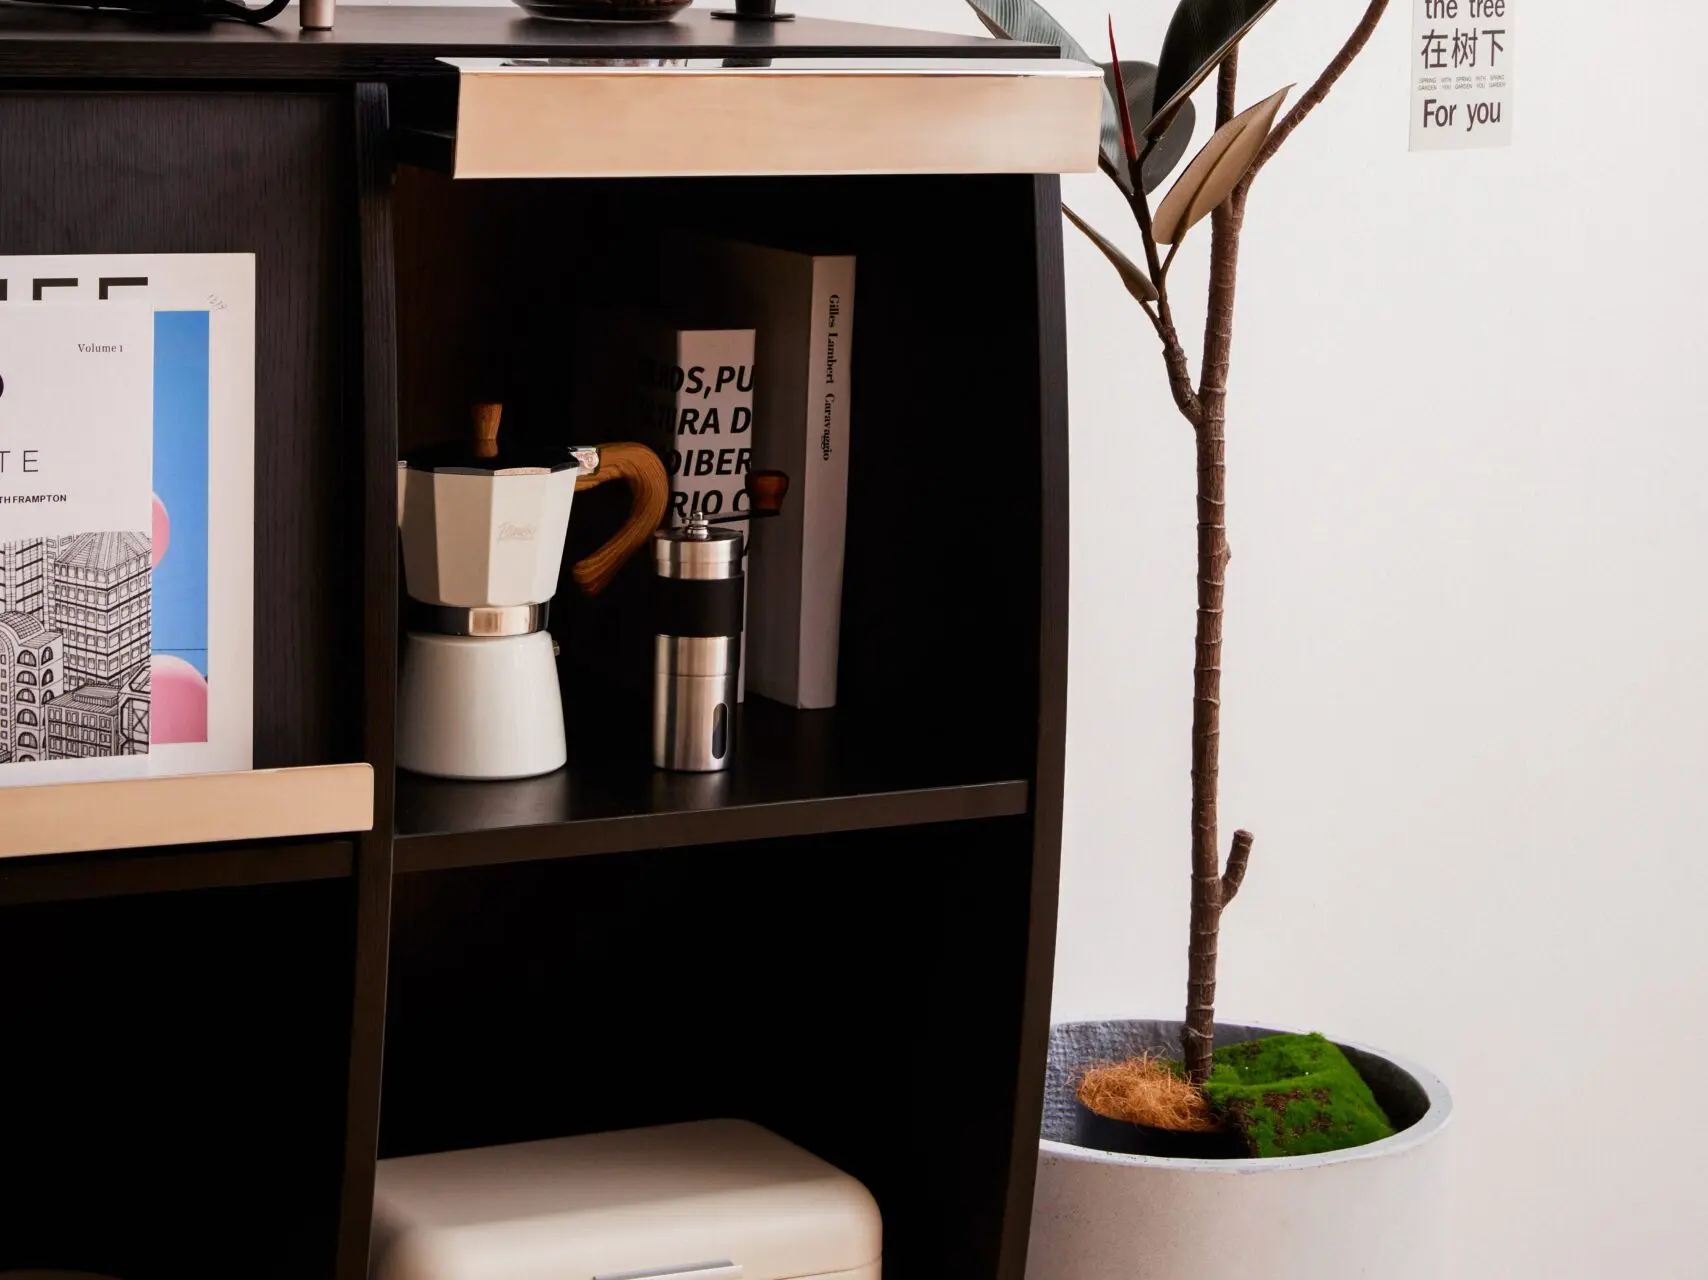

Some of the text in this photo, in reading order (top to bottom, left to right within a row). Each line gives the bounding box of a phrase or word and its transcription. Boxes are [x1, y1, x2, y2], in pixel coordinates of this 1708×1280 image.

[1420, 27, 1507, 70] 在树下
[1423, 99, 1501, 132] For you
[77, 343, 116, 353] Volume
[821, 294, 840, 461] Gilles Lambert Caravaggio
[13, 495, 67, 504] FRAMPTON
